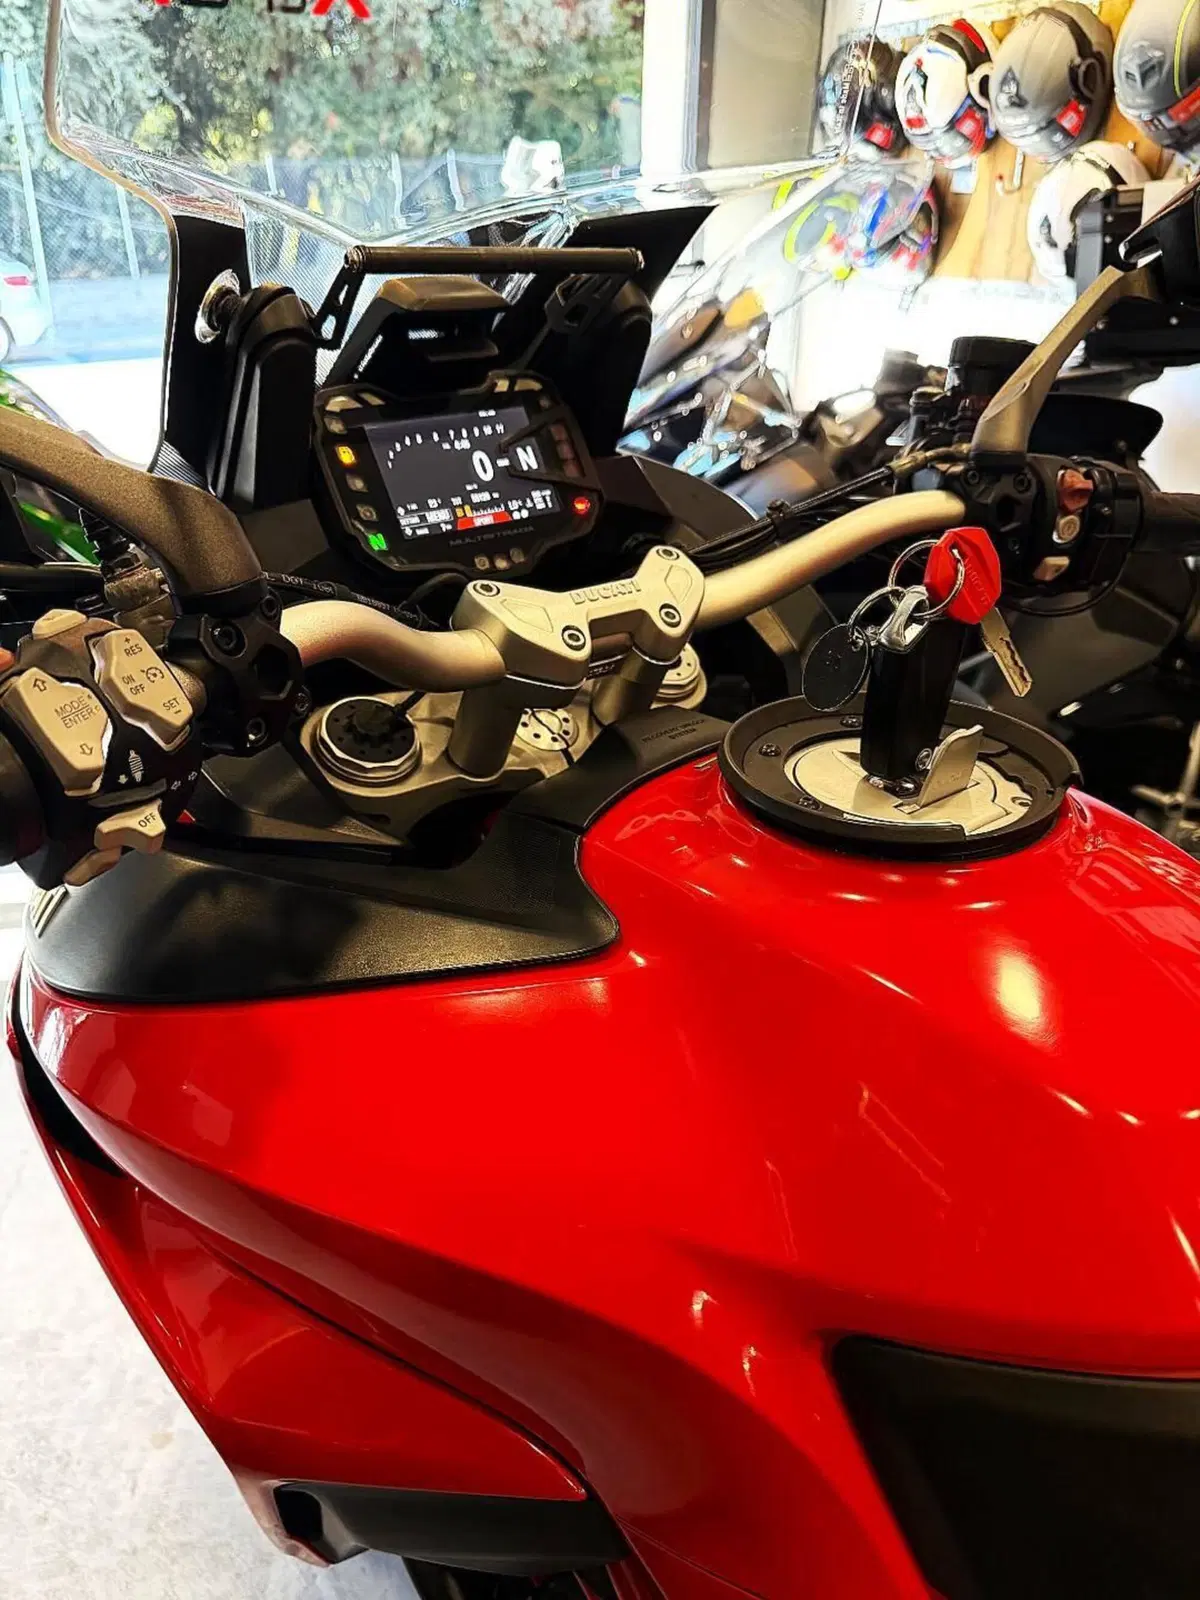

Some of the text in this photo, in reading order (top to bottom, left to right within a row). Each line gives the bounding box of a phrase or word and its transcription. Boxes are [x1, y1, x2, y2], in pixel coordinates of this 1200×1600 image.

[472, 445, 539, 482] 0 N
[569, 579, 641, 605] DUCATI
[124, 644, 143, 657] RES
[121, 674, 136, 685] ON
[129, 684, 147, 696] OFF
[54, 695, 88, 718] MODE
[162, 697, 181, 711] SET
[63, 709, 95, 729] ENTER
[138, 812, 157, 828] OFF
